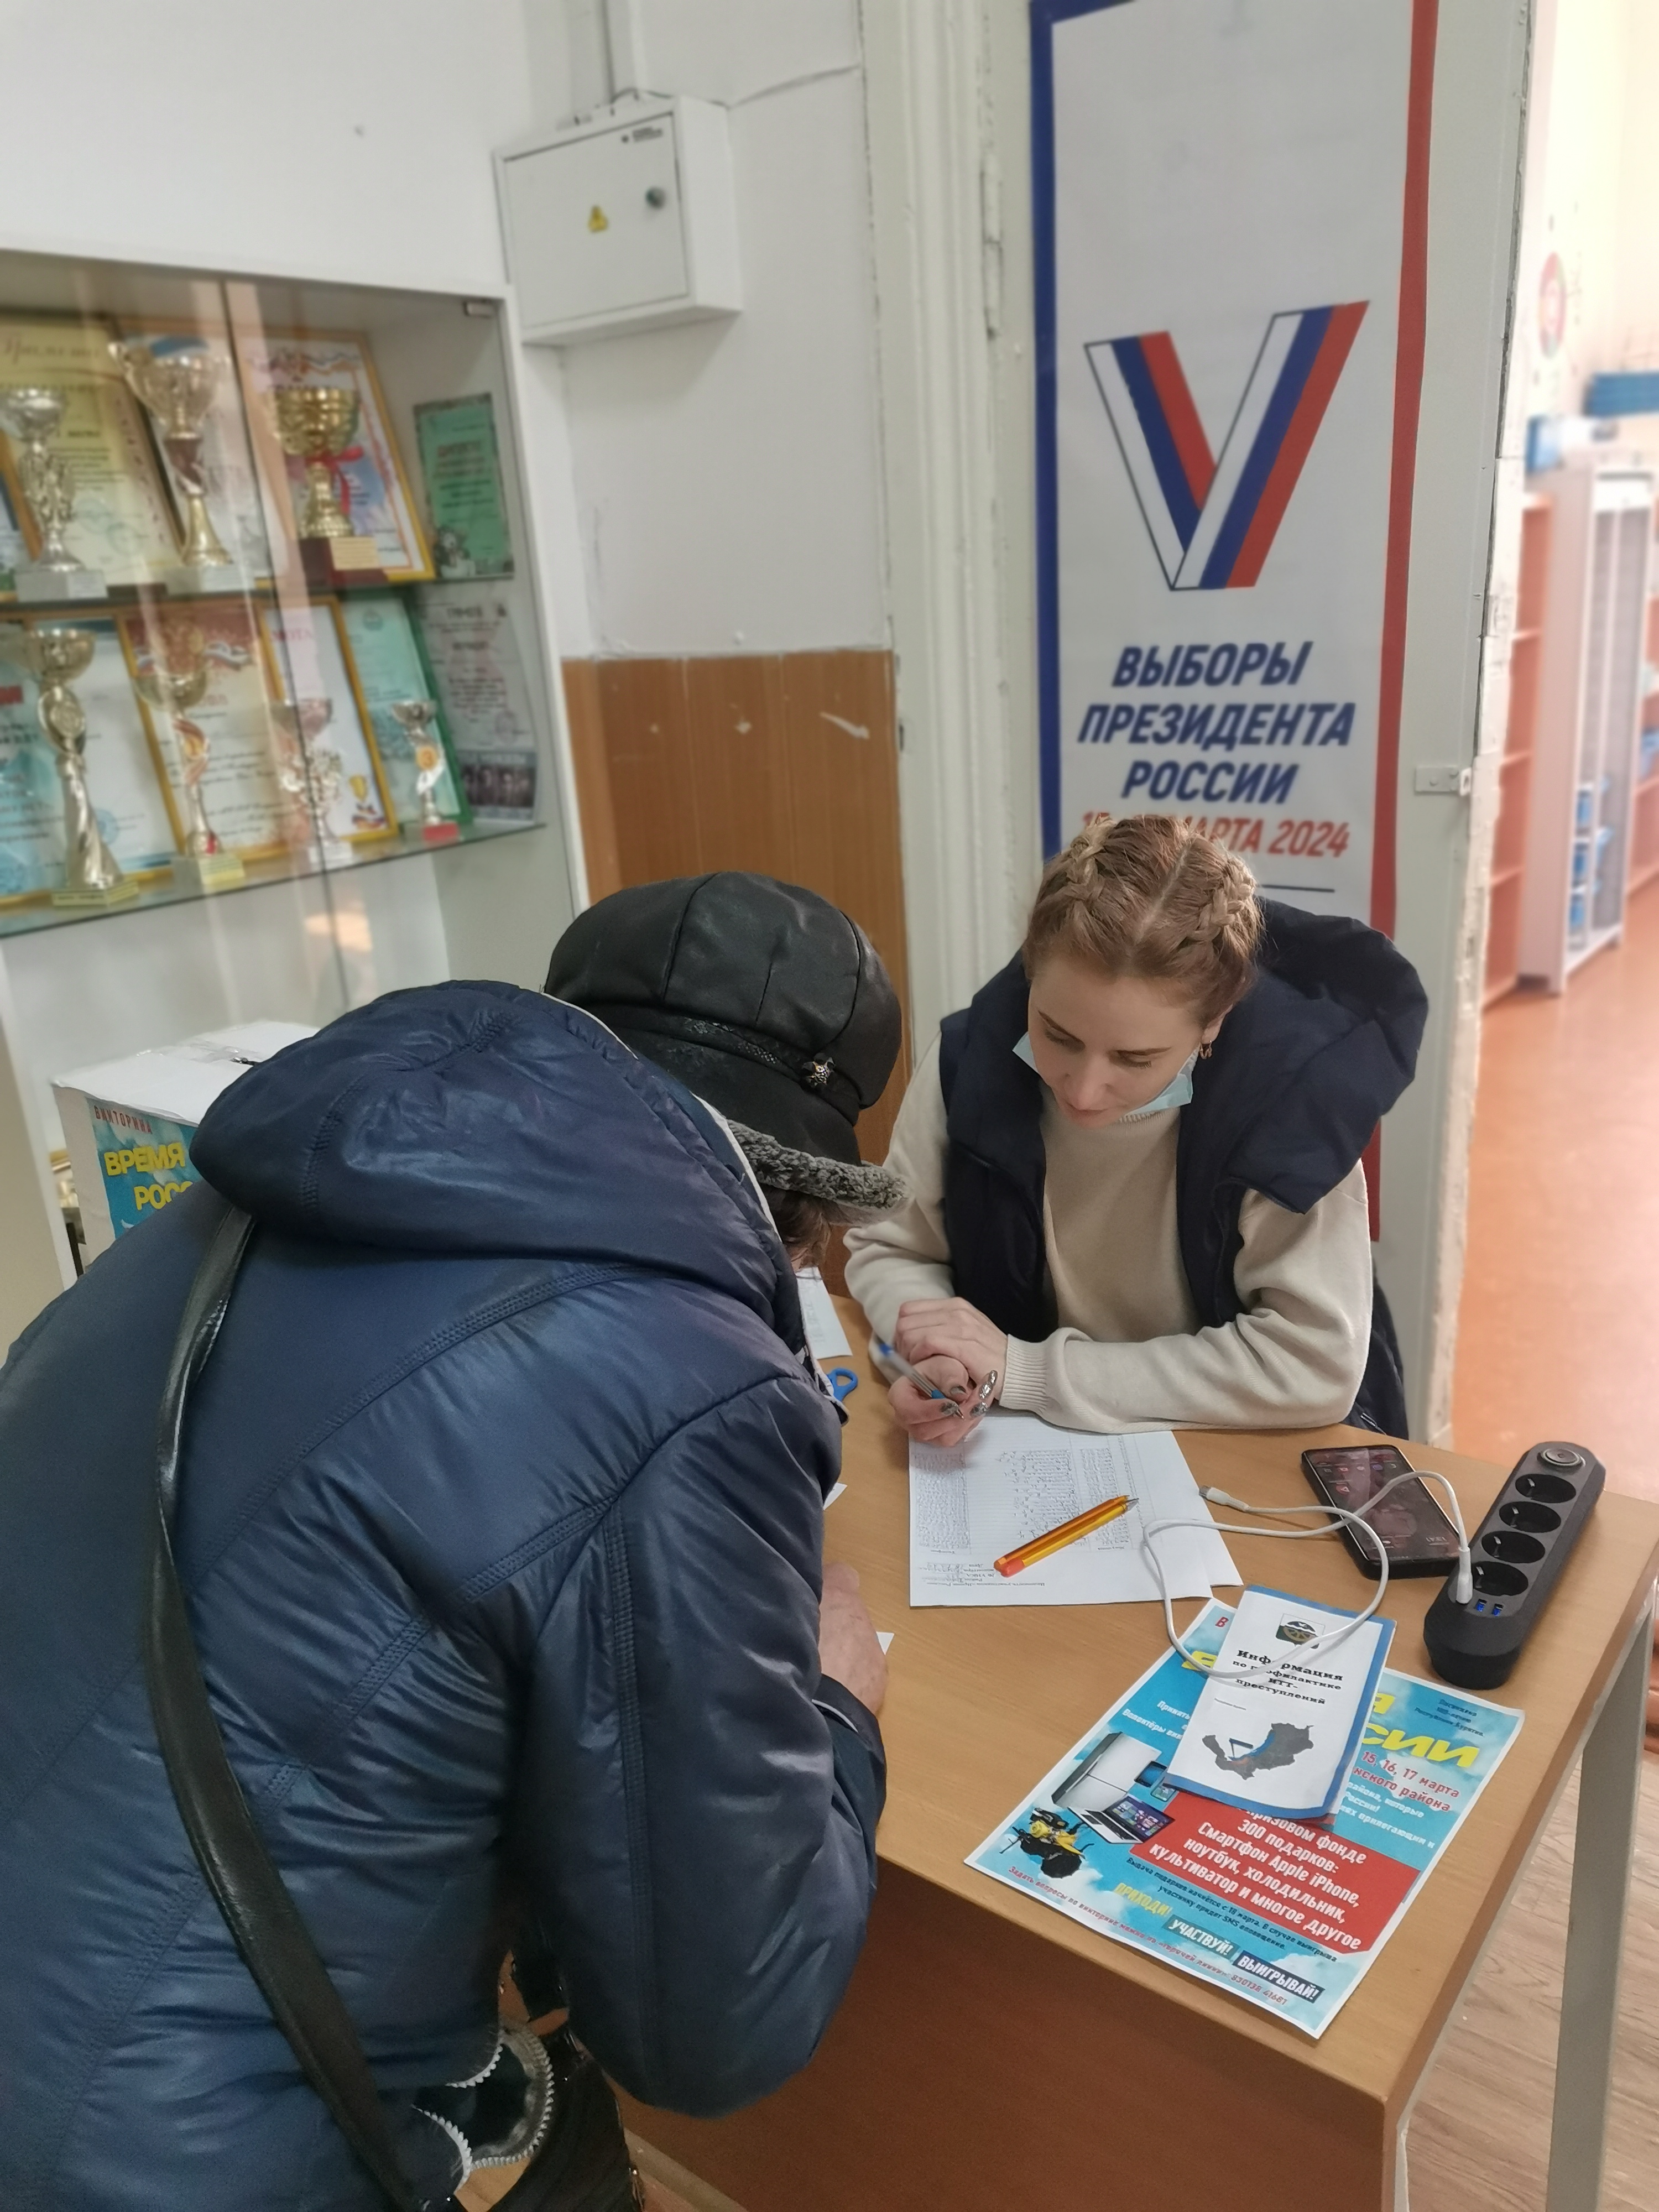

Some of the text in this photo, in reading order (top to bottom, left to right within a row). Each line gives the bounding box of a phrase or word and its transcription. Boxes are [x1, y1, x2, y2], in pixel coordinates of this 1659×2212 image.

[1111, 640, 1314, 687] ВЫБОРЫ
[1077, 702, 1356, 752] ПРЕЗИДЕНТА
[1120, 760, 1300, 804] РОССИИ
[1185, 815, 1349, 858] АРТА 2024
[93, 1105, 152, 1134] ВИКТОРИНА
[103, 1142, 186, 1176] ВРЕМЯ
[1237, 1650, 1343, 1681] Инфрмация
[1235, 1678, 1326, 1704] преступлений
[1361, 1751, 1461, 1798] 15, 16, 17 марта
[1399, 1786, 1452, 1812] района
[1198, 1822, 1360, 1908] Смартфон Apple iPhone,
[1238, 1819, 1339, 1874] 300 подарков:
[1316, 1835, 1367, 1864] фонде
[1009, 1866, 1034, 1884] Задать
[1183, 1838, 1346, 1924] ноутбук, холодильник,
[1114, 1882, 1172, 1917] ПРИХОДИ!
[1149, 1843, 1362, 1950] культиватор и многое другое
[1168, 1919, 1234, 1955] УЧАСТВУЙ!
[1222, 1916, 1240, 1927] SMS
[1237, 1955, 1320, 2000] ВЫИГРЫВАЙ!
